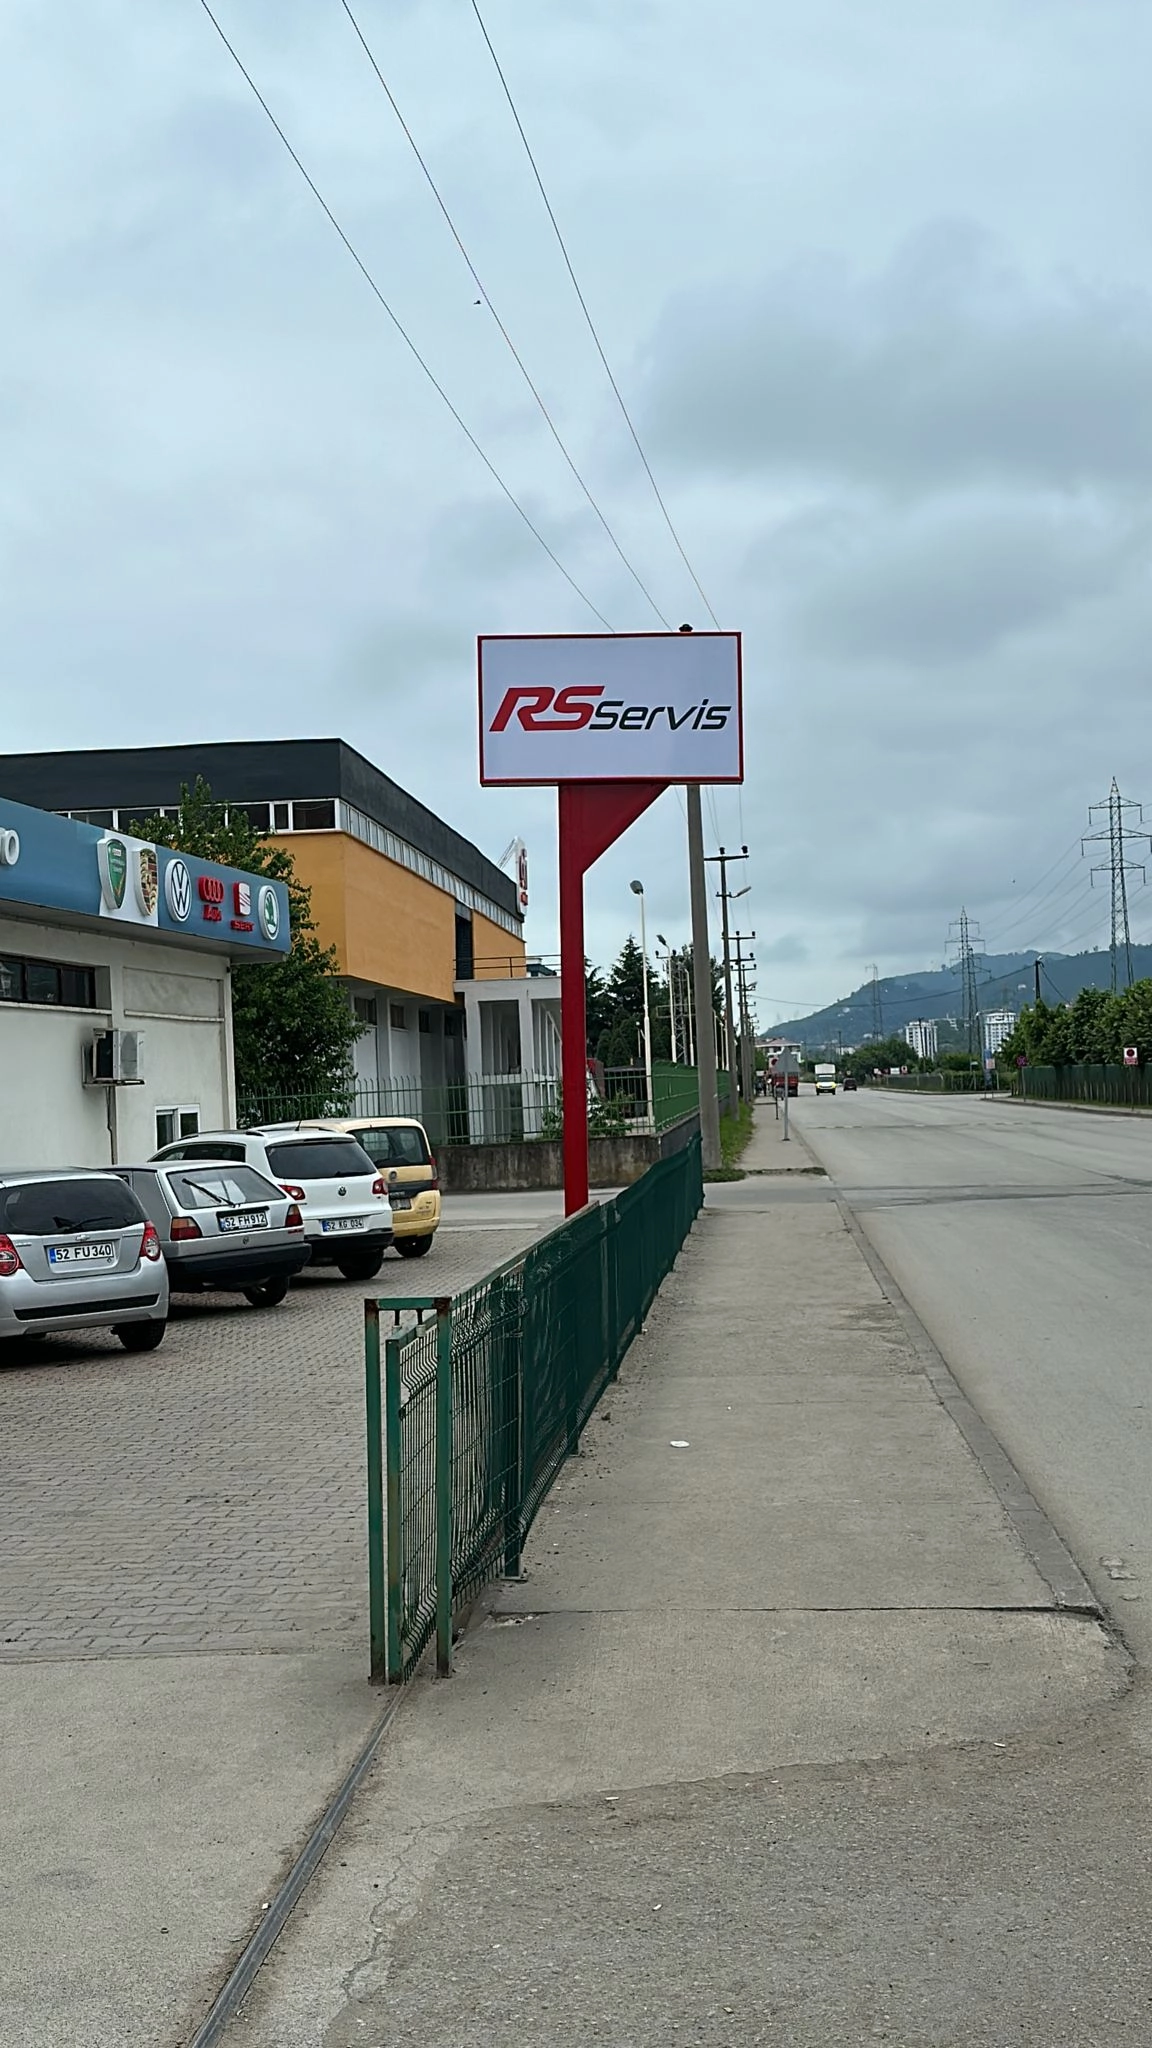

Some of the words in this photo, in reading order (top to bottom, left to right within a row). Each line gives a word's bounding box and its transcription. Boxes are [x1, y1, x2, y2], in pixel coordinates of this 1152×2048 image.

[489, 686, 605, 732] RS
[588, 698, 732, 731] Servis
[225, 1217, 236, 1227] 52
[327, 1221, 336, 1230] 52
[56, 1248, 70, 1260] 52
